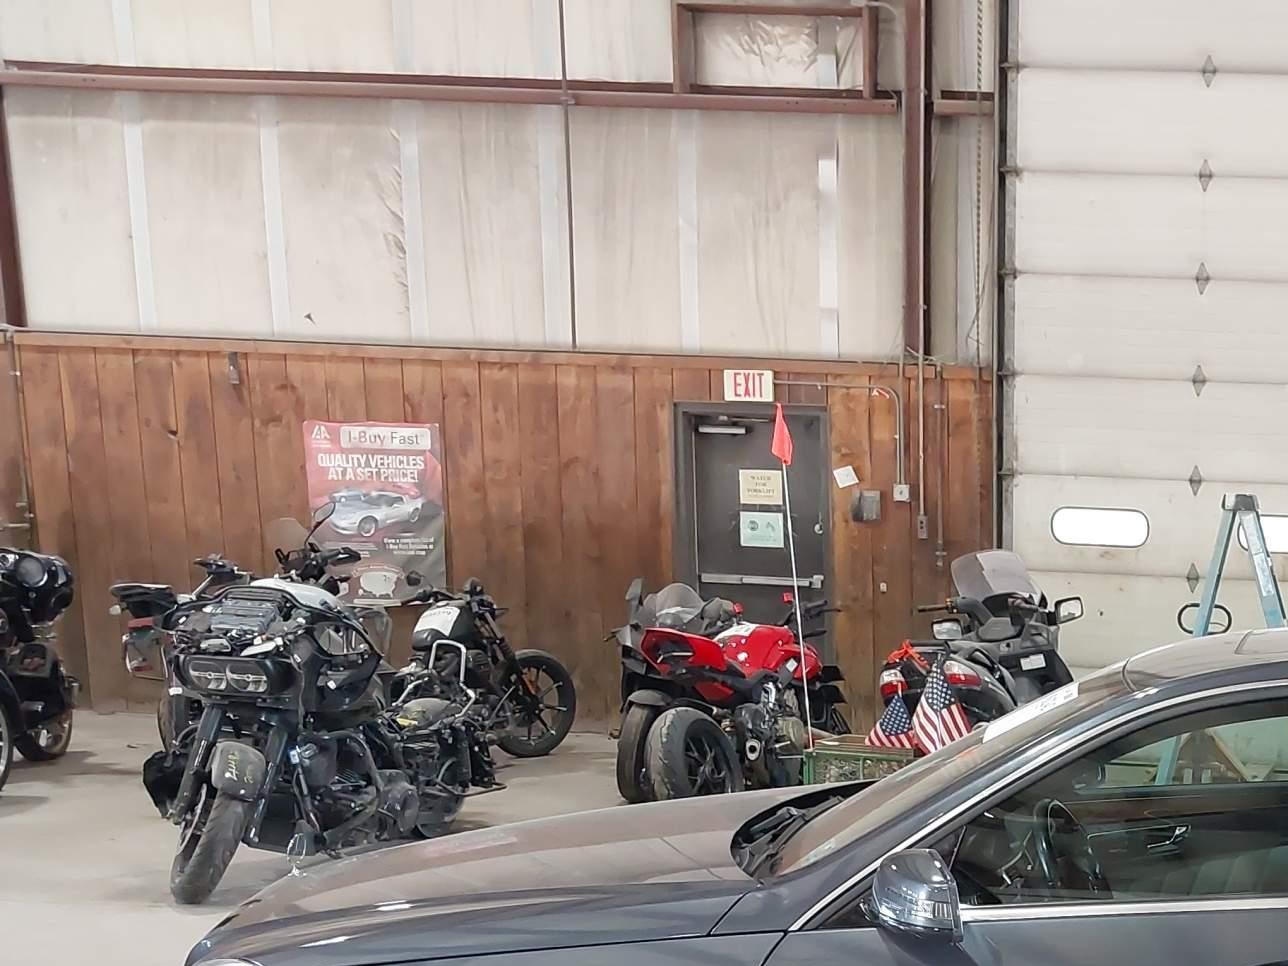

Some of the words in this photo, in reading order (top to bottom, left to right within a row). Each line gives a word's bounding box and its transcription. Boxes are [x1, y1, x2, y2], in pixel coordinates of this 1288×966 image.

[734, 372, 764, 398] EXIT
[348, 430, 385, 445] I-Buy
[391, 431, 420, 445] Fast
[317, 453, 366, 468] QUALITY
[368, 455, 425, 469] VEHICLES
[328, 468, 345, 480] AT
[346, 468, 355, 480] A
[359, 468, 378, 481] SET
[380, 469, 419, 483] PRICE!
